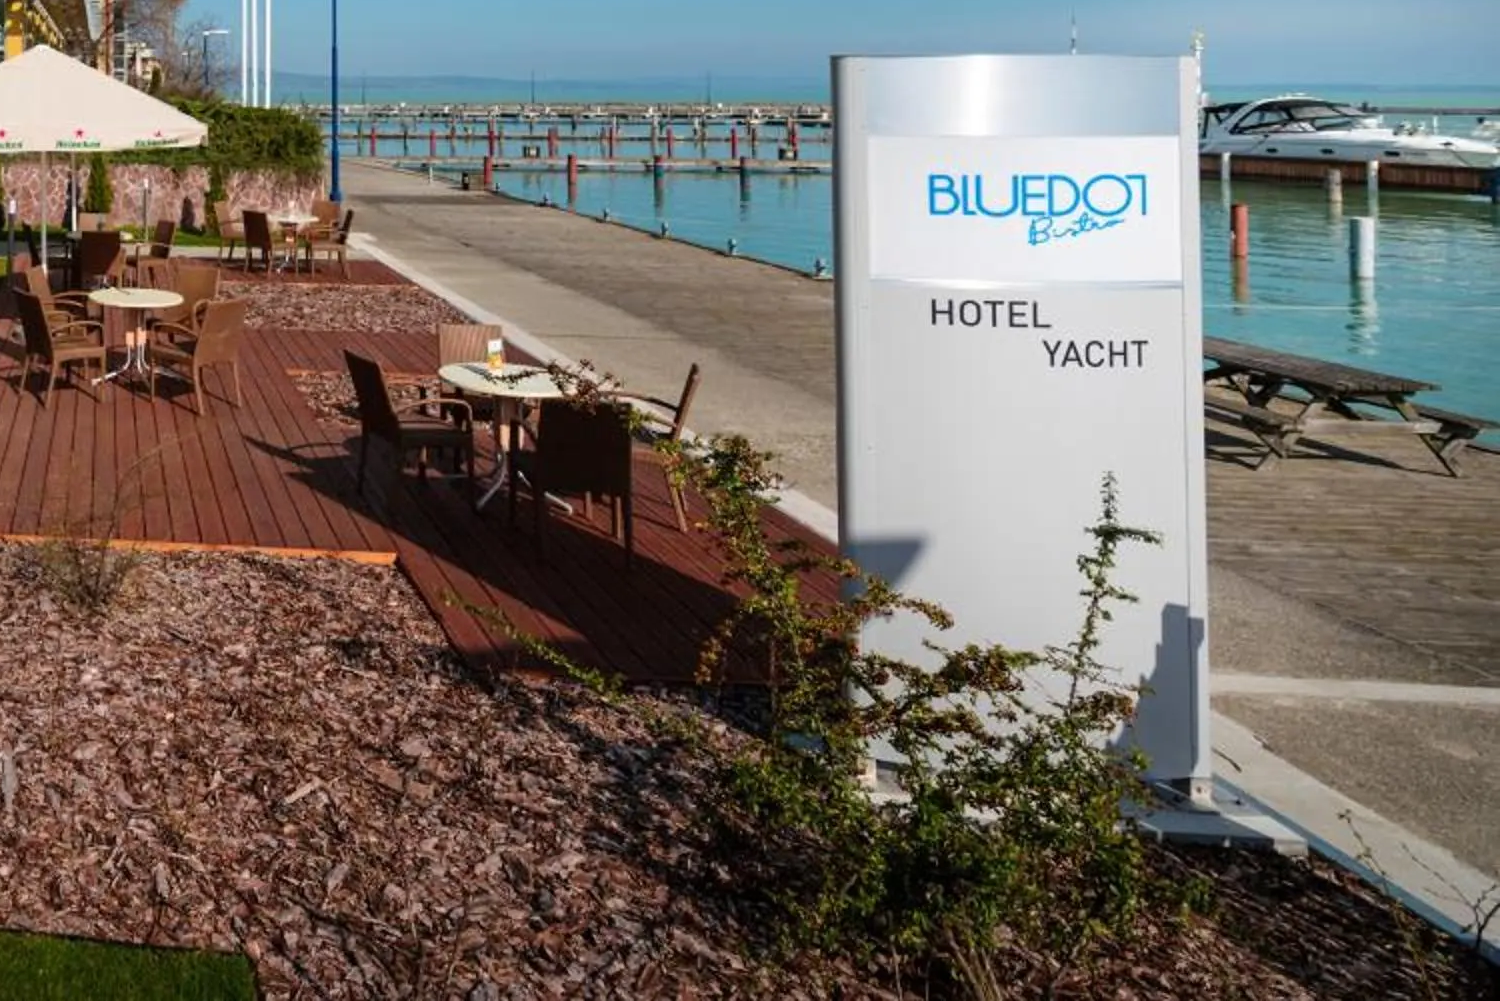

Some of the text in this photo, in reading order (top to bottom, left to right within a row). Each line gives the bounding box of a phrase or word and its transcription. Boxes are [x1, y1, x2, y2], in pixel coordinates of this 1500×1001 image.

[928, 174, 1147, 216] BLUEDOT
[1028, 213, 1125, 245] Bistro
[931, 299, 1052, 328] HOTEL
[1043, 340, 1149, 367] YACHT
